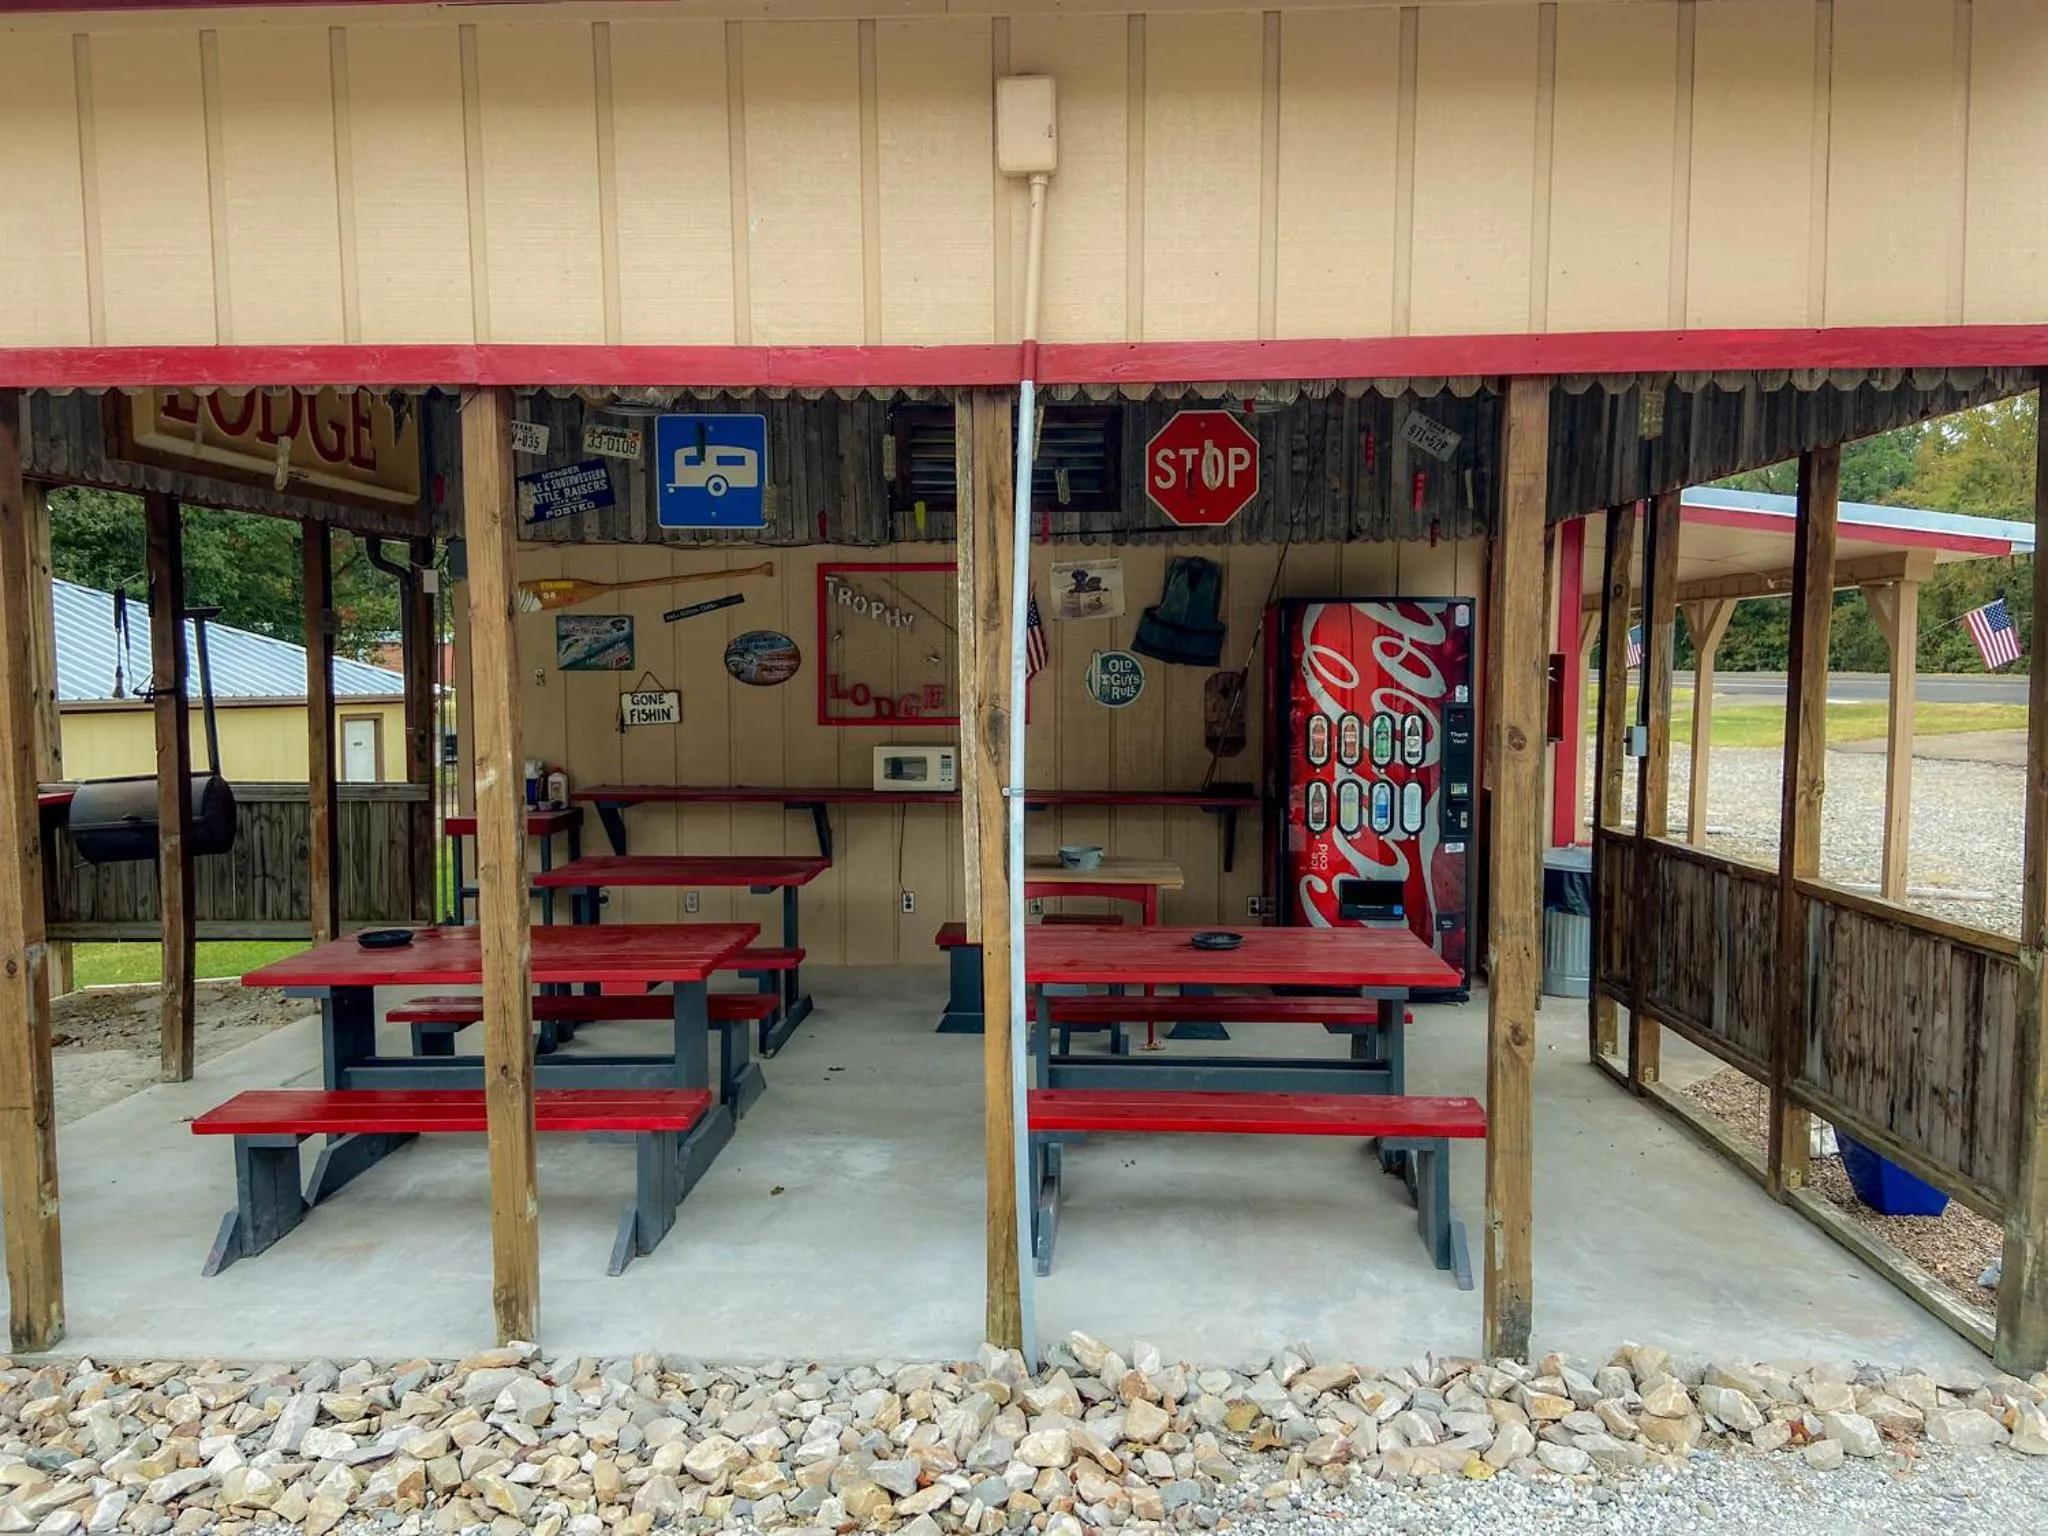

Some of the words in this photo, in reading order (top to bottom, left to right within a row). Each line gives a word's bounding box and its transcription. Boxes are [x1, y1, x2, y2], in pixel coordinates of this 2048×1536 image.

[541, 465, 580, 480] MEMBER
[1154, 447, 1251, 490] STOP
[531, 488, 561, 505] ATTLE
[563, 479, 608, 498] RAISERS
[545, 501, 596, 519] POSTED
[825, 574, 914, 631] TROPHY
[1108, 660, 1133, 673] OLD
[1111, 673, 1140, 686] GUYS
[631, 693, 666, 705] GONE
[828, 673, 945, 718] LODGE
[1111, 684, 1137, 699] RULE
[1317, 843, 1328, 871] cold
